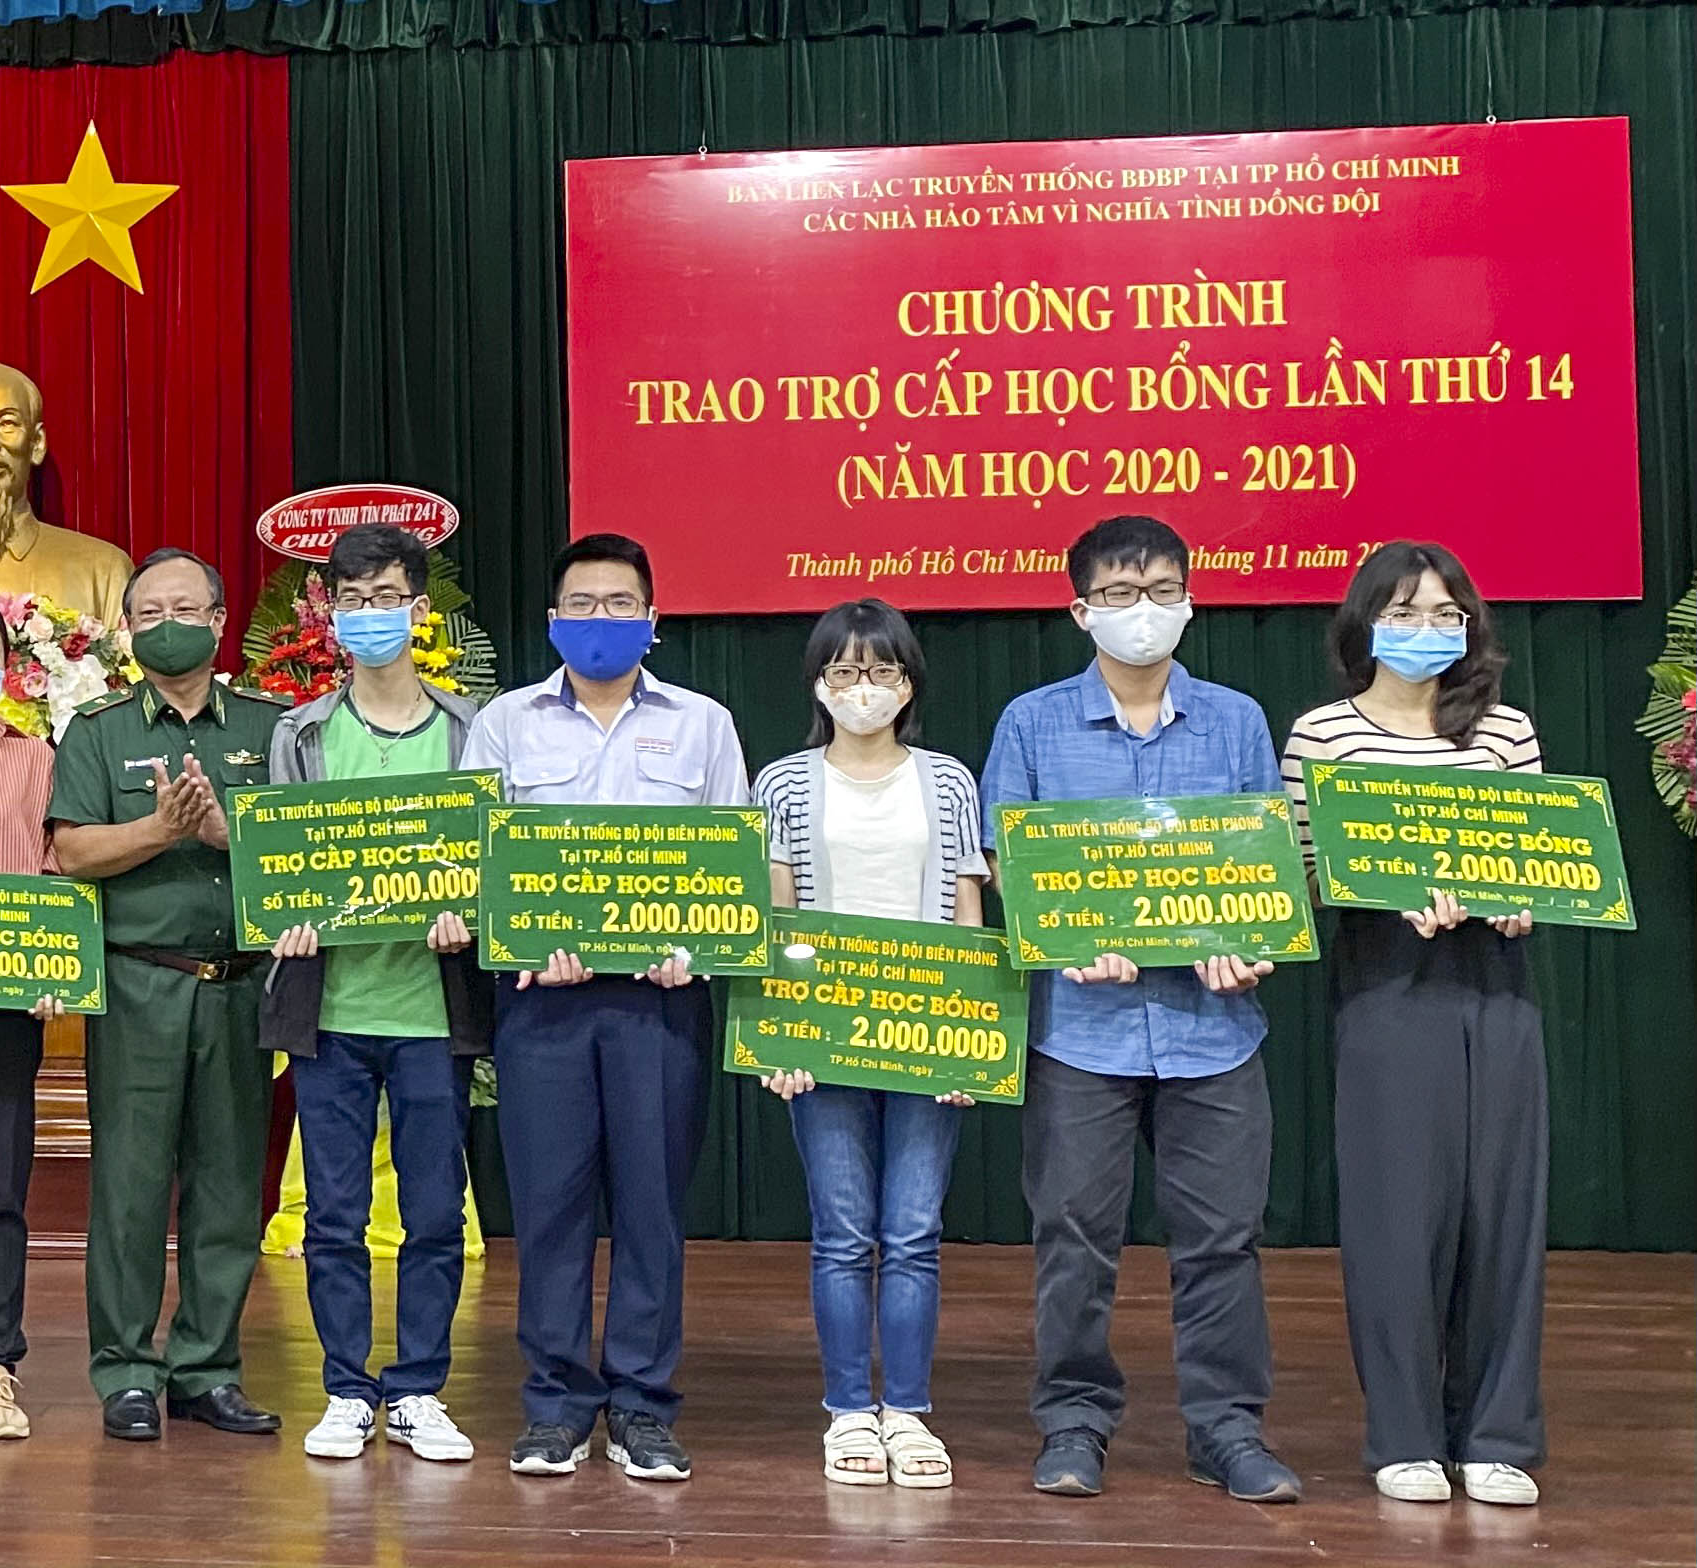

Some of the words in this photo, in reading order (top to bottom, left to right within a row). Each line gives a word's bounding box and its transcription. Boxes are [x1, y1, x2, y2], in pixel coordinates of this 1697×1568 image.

[728, 182, 778, 202] BAN
[852, 178, 903, 202] LẠC
[910, 165, 1014, 196] TRUYỀN
[1021, 162, 1112, 191] THỐNG
[1122, 168, 1188, 188] BĐBP
[1197, 165, 1238, 189] TẠI
[1246, 164, 1279, 183] TP
[1286, 152, 1324, 182] HỒ
[1331, 154, 1379, 180] CHÍ
[1386, 156, 1461, 177] MINH
[804, 208, 859, 232] CÁC
[863, 204, 917, 230] NHÀ
[924, 202, 980, 228] HẢO
[986, 202, 1044, 226] TÂM
[1052, 199, 1078, 224] VÌ
[1086, 197, 1170, 222] NGHĨA
[1177, 194, 1241, 218] TÌNH
[1249, 188, 1325, 216] ĐỒNG
[1332, 188, 1381, 217] ĐỘI
[897, 280, 1113, 337] CHƯƠNG
[1126, 267, 1288, 330] TRÌNH
[628, 377, 765, 425] TRAO
[777, 366, 882, 432] TRỢ
[894, 348, 992, 419] CẤP
[1004, 366, 1113, 427] HỌC
[1126, 340, 1272, 412] BỔNG
[1283, 337, 1388, 408] LẦN
[1402, 340, 1511, 405] THỨ
[1525, 352, 1575, 401] 14
[837, 441, 967, 509] (NĂM
[980, 449, 1091, 510] HỌC
[1103, 446, 1202, 495] 2020
[1241, 443, 1357, 499] 2021)
[278, 506, 309, 529] CÔNG
[310, 509, 326, 526] TY
[327, 507, 358, 525] TNHH
[361, 501, 380, 524] TÍN
[383, 499, 414, 523] PHÁT
[415, 502, 437, 520] 241
[281, 530, 338, 549] CHÚ
[787, 553, 862, 577] Thành
[867, 546, 918, 582] phố
[920, 546, 956, 575] Hồ
[962, 549, 1005, 574] Chí
[1188, 545, 1255, 575] tháng
[1263, 544, 1288, 569] 11
[1297, 544, 1348, 569] năm
[509, 825, 531, 839] BLL
[667, 824, 695, 840] BIÊN
[1342, 821, 1394, 845] TRỢ
[1457, 829, 1513, 852] HỌC
[1520, 827, 1592, 857] BỔNG
[560, 849, 580, 866] Tại
[626, 846, 649, 864] CHÍ
[652, 850, 687, 864] MINH
[1432, 850, 1601, 892] 2.000.000Đ
[345, 866, 480, 906] 2.000.000
[509, 873, 557, 897] TRỢ
[617, 875, 669, 898] HỌC
[675, 867, 744, 895] BỔNG
[1032, 869, 1082, 894] TRỢ
[1144, 867, 1199, 891] HỌC
[1205, 857, 1277, 885] BỔNG
[602, 901, 759, 934] 2.000.000Đ
[1134, 891, 1293, 927] 2.000.000Đ
[20, 925, 79, 949] BỔNG
[762, 978, 810, 1004] TRỢ
[870, 990, 924, 1015] HỌC
[930, 988, 1000, 1022] BỔNG
[850, 1016, 1007, 1062] 2.000.000Đ
